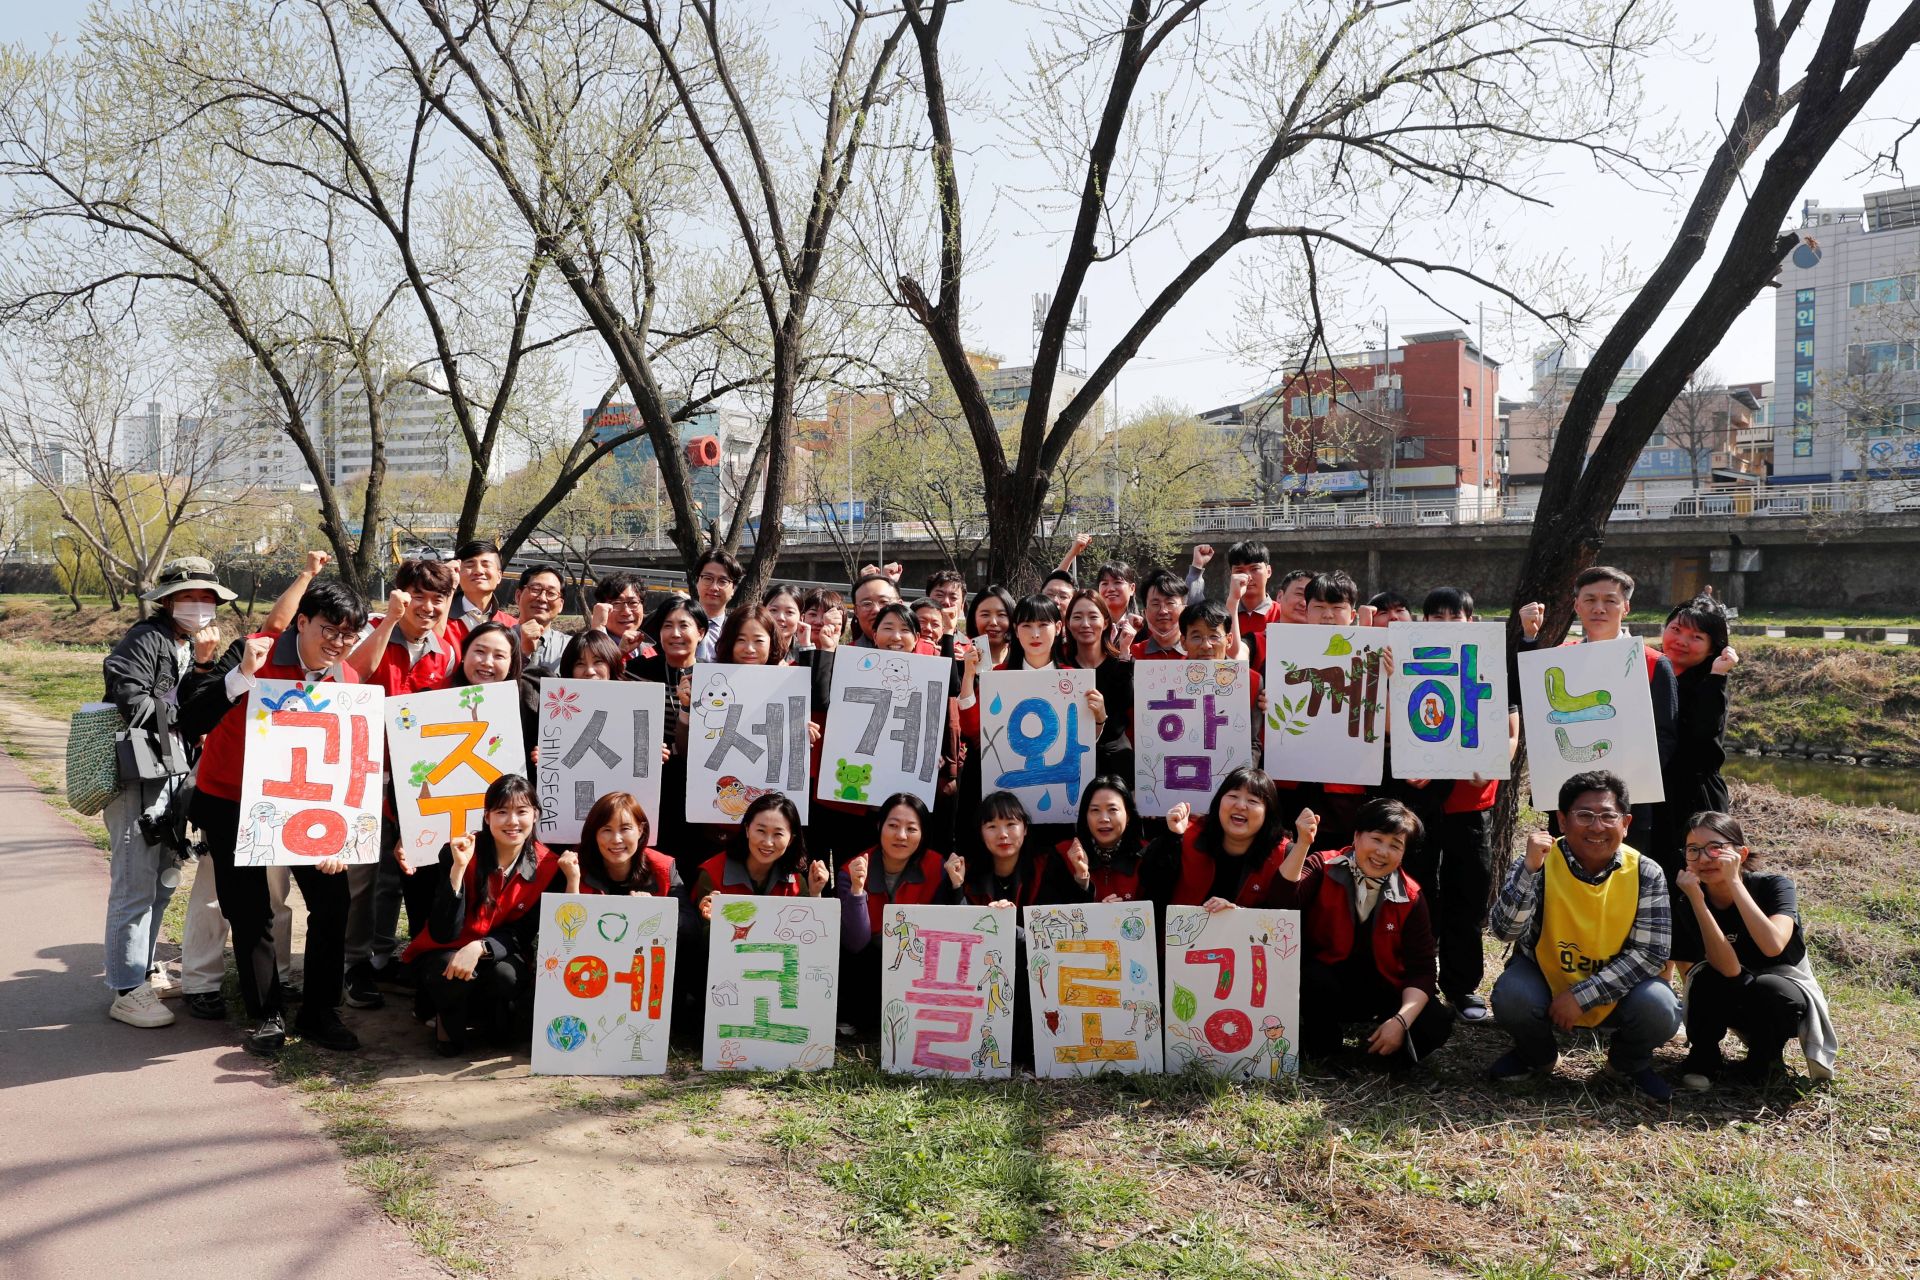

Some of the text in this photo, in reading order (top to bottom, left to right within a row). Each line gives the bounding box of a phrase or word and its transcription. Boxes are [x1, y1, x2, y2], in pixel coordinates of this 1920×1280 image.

[704, 695, 807, 792] 세
[842, 681, 943, 783] 계
[1147, 689, 1229, 792] 함
[1285, 650, 1381, 743] 께
[1402, 643, 1493, 749] 하
[1544, 666, 1617, 764] 는
[262, 710, 380, 857] 광
[416, 721, 504, 838] 주
[539, 725, 559, 833] SHINSEGAE
[560, 709, 650, 821] 신
[994, 697, 1091, 807] 와
[563, 945, 667, 1020] 에
[717, 942, 811, 1046] 코
[904, 929, 985, 1073] 플
[1053, 938, 1140, 1064] 로
[1184, 944, 1268, 1054] 깅
